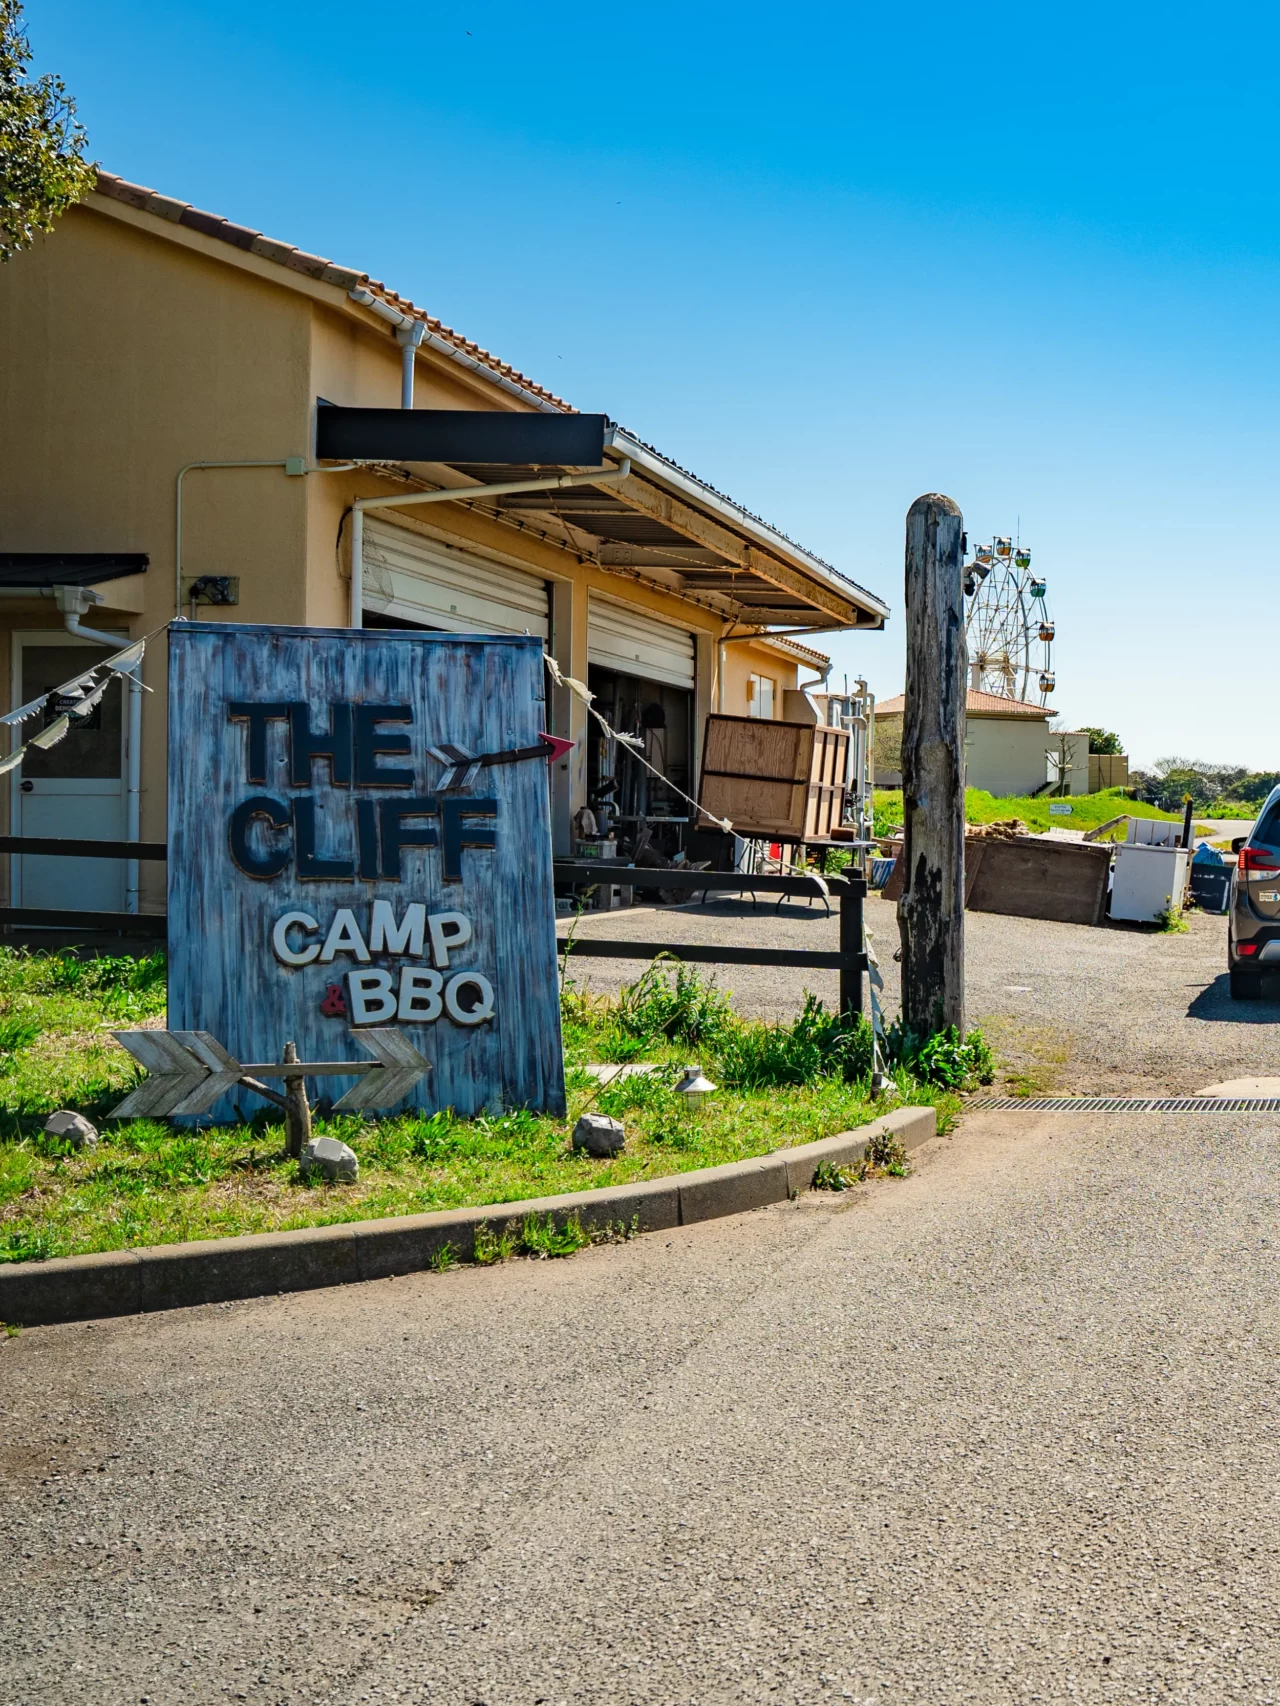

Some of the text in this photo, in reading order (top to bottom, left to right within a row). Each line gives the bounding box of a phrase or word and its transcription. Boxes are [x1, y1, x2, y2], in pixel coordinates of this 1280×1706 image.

[228, 702, 415, 788] THE
[228, 796, 499, 882] CLIFF
[272, 899, 472, 969] CAMP
[321, 967, 496, 1027] & BBQ
